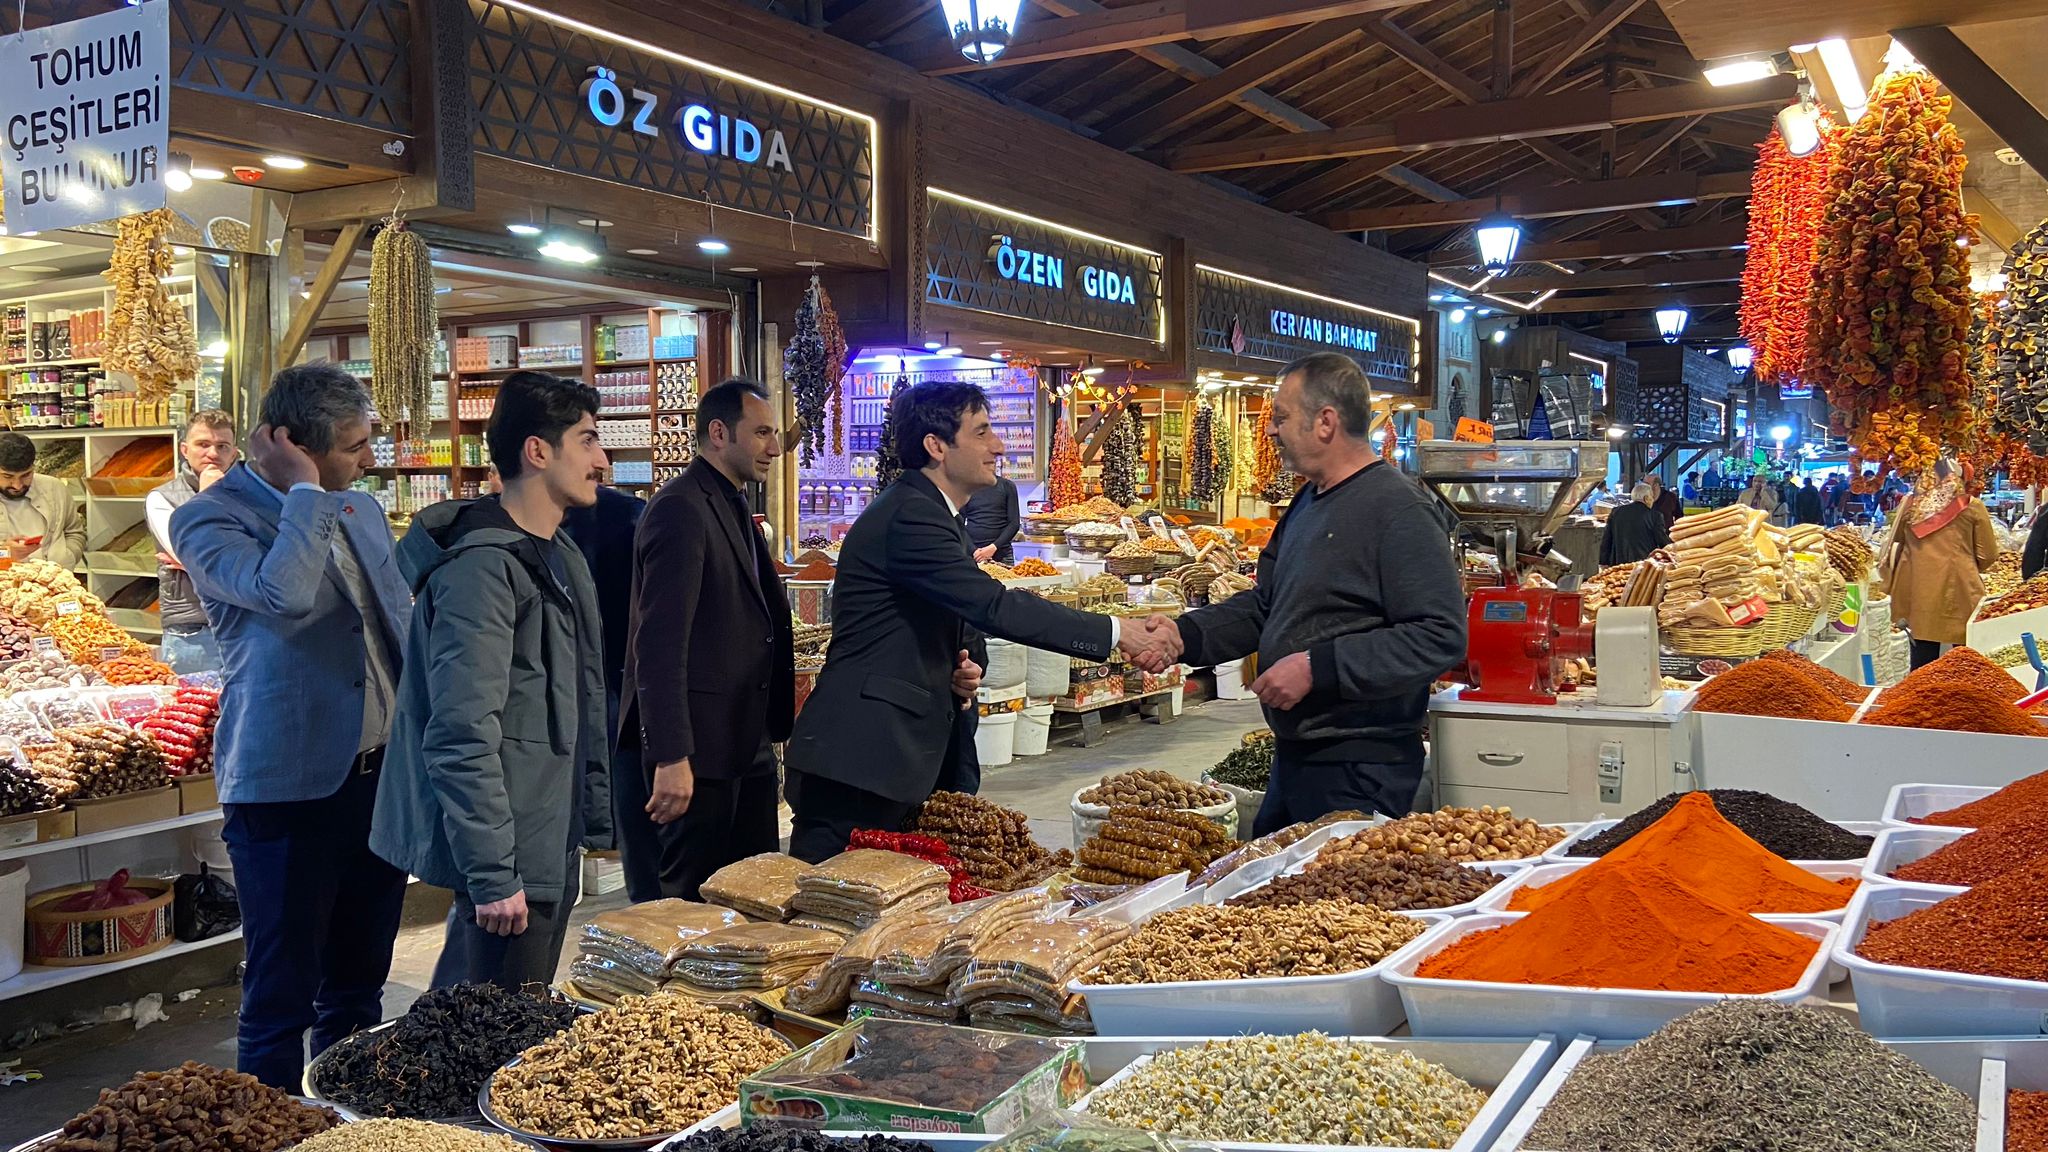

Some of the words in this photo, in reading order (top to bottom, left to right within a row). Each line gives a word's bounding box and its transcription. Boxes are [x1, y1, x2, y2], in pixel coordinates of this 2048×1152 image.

[30, 30, 142, 90] TOHUM
[8, 74, 161, 162] ÇEŞİTLERİ
[587, 65, 660, 138] ÖZ
[682, 103, 793, 174] GIDA
[996, 235, 1064, 290] ÖZEN
[1083, 265, 1136, 306] GIDA
[1270, 309, 1322, 343] KERVAN
[1324, 320, 1378, 353] BAHARAT
